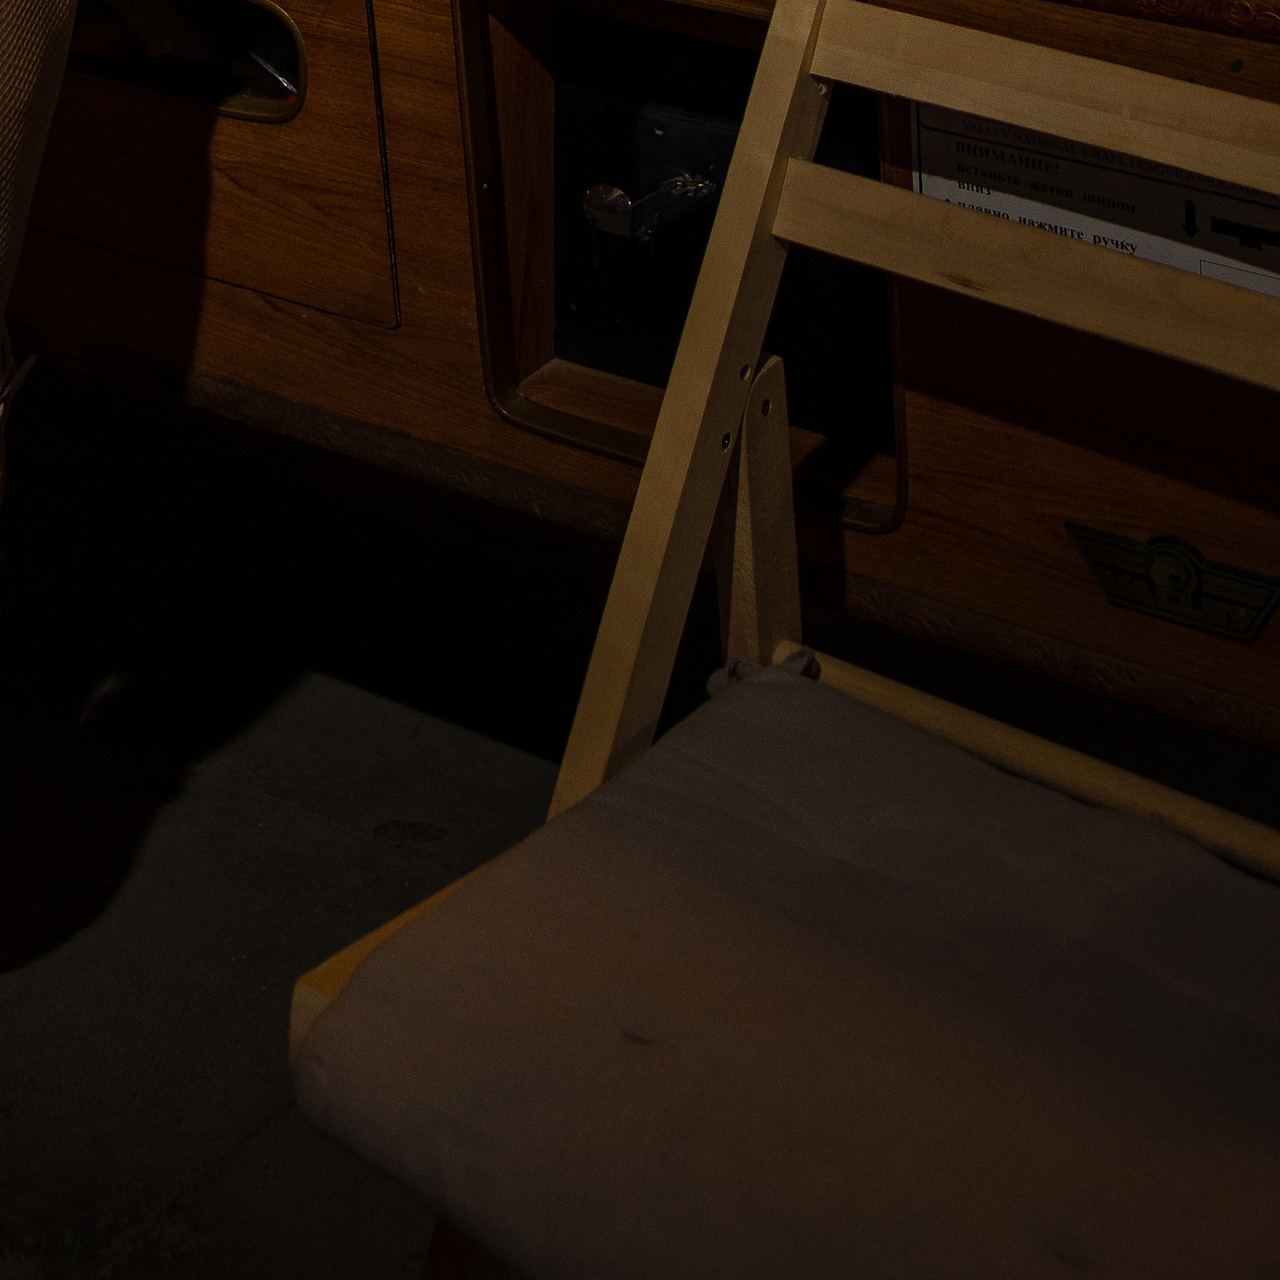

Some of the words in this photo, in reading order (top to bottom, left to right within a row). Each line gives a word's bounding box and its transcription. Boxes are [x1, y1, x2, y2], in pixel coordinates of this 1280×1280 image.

[955, 140, 1060, 176] ВНИМАНИЕ!
[962, 120, 1009, 139] VALLEY
[1013, 132, 1076, 154] NATIONAL
[1130, 156, 1184, 180] LEAGUE
[956, 162, 1021, 187] вставьте
[1029, 180, 1073, 199] жетон
[957, 179, 992, 197] вниз
[1018, 215, 1084, 240] нажмите
[1092, 233, 1138, 255] ручку
